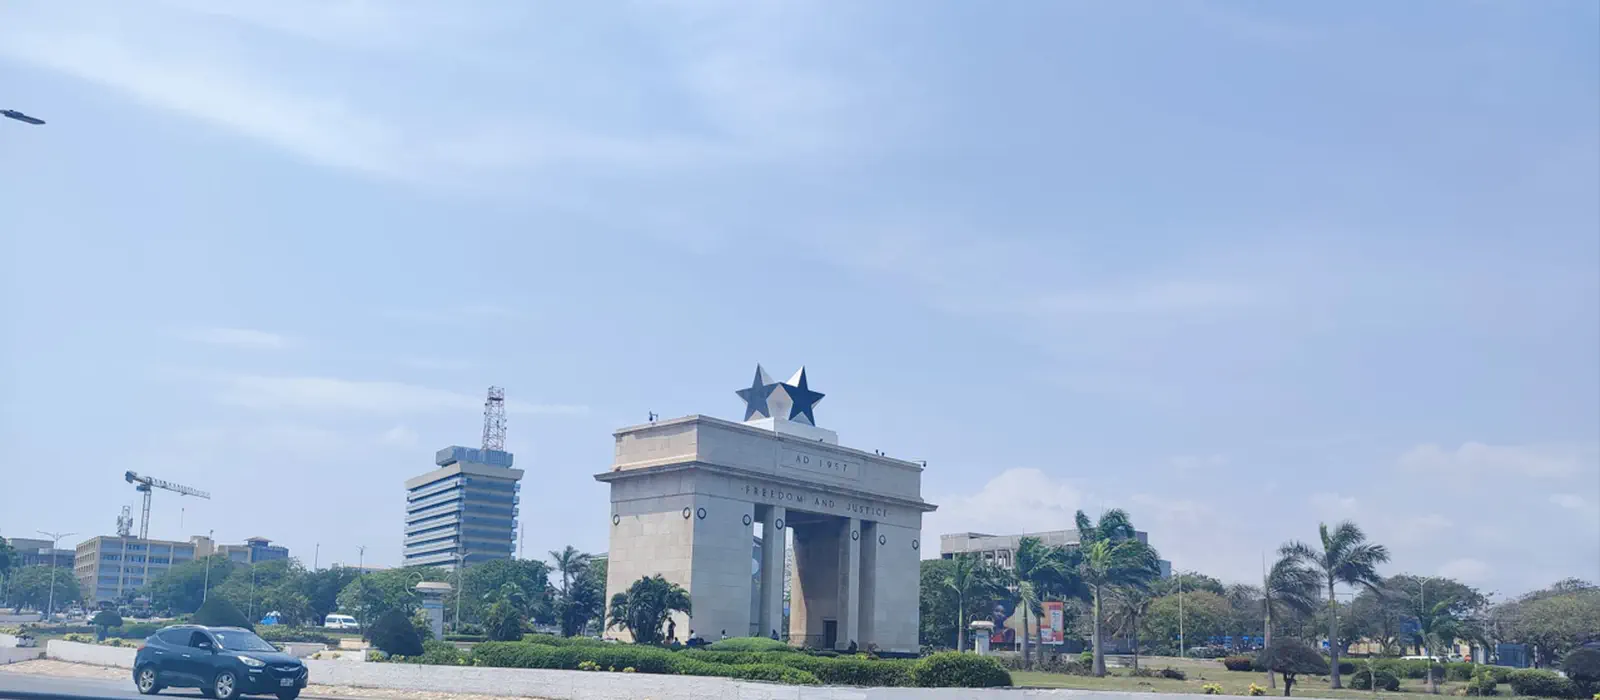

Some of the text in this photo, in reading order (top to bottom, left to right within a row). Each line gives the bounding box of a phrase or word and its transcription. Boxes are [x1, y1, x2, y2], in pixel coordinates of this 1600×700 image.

[795, 455, 848, 472] AD 1957
[745, 485, 888, 517] FREEDOM AND JUSTICE
